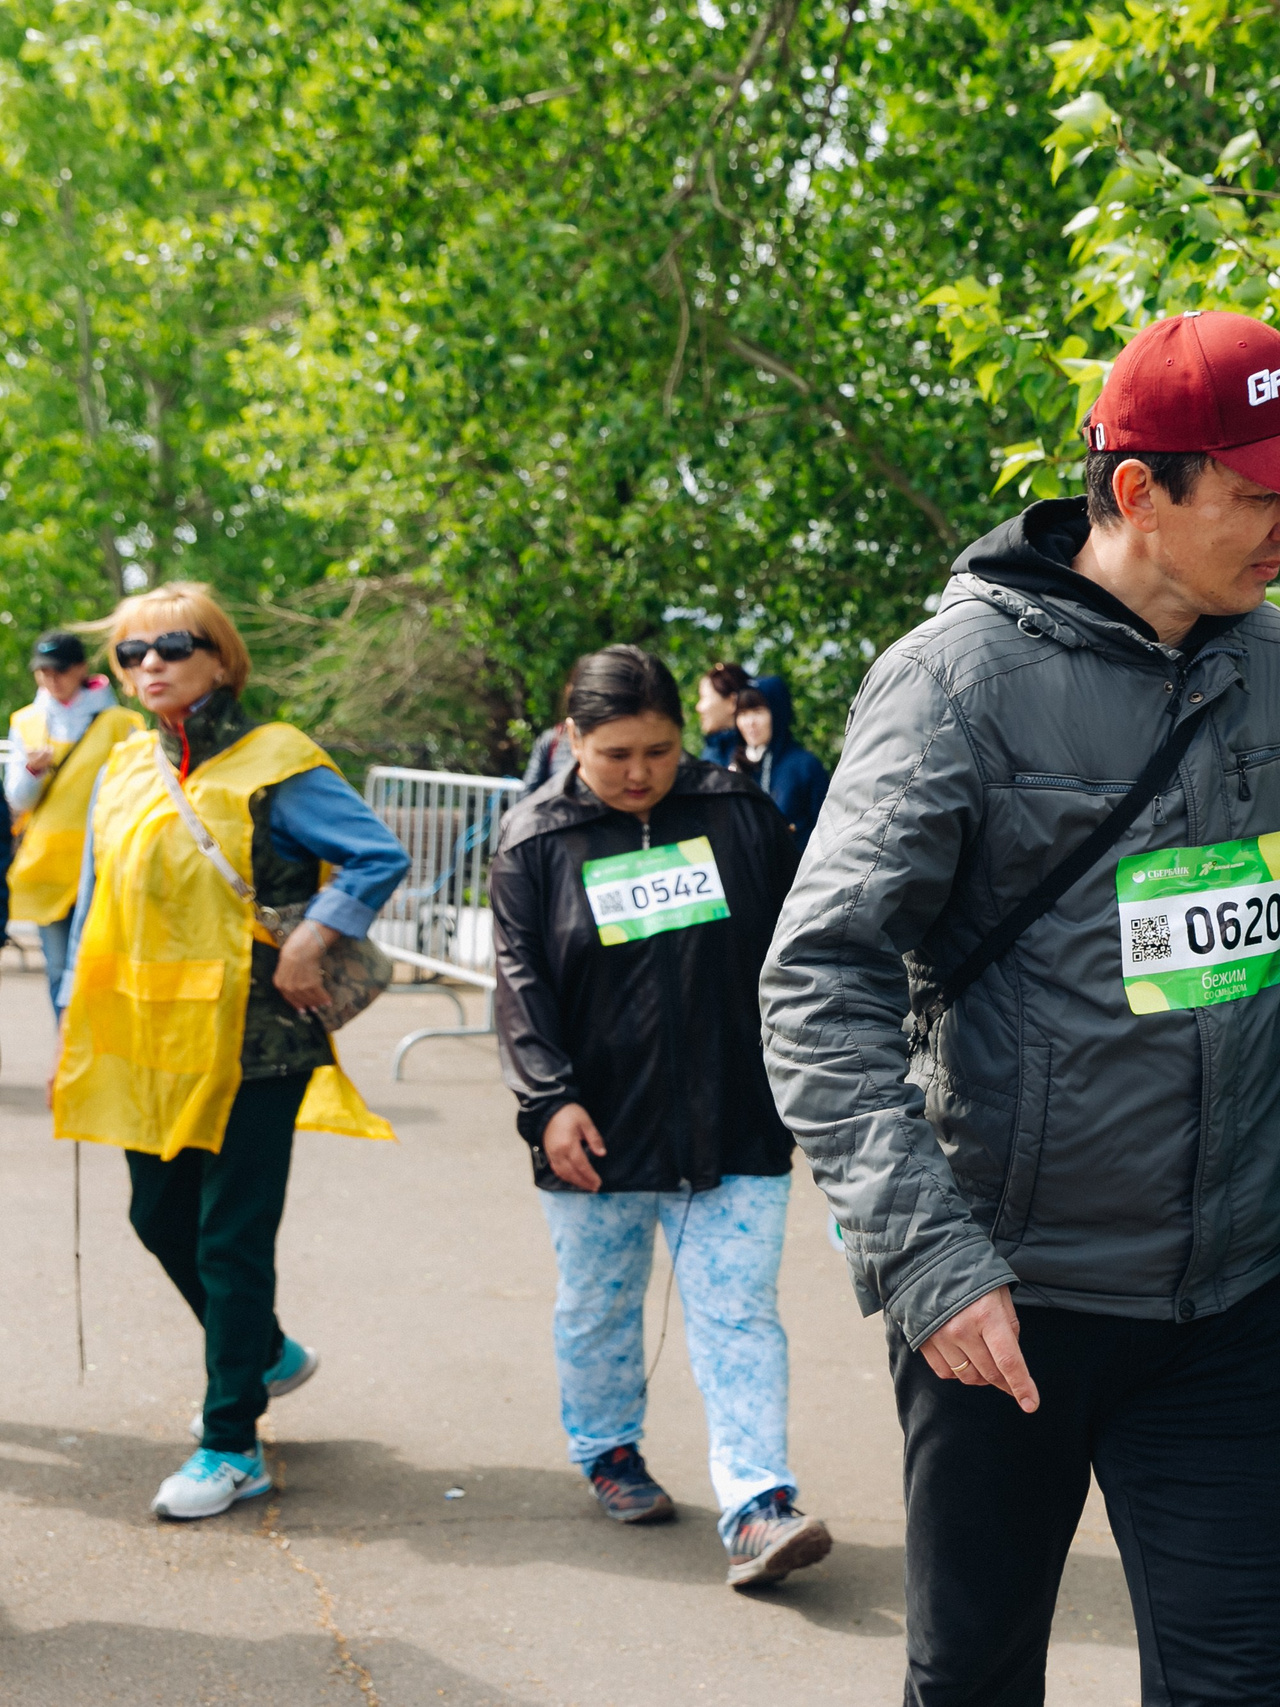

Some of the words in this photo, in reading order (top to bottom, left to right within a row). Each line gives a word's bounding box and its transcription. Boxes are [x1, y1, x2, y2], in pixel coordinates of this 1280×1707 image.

[1147, 866, 1190, 880] СБЕРБАНК
[631, 871, 713, 910] 0542
[1201, 968, 1247, 990] бежим
